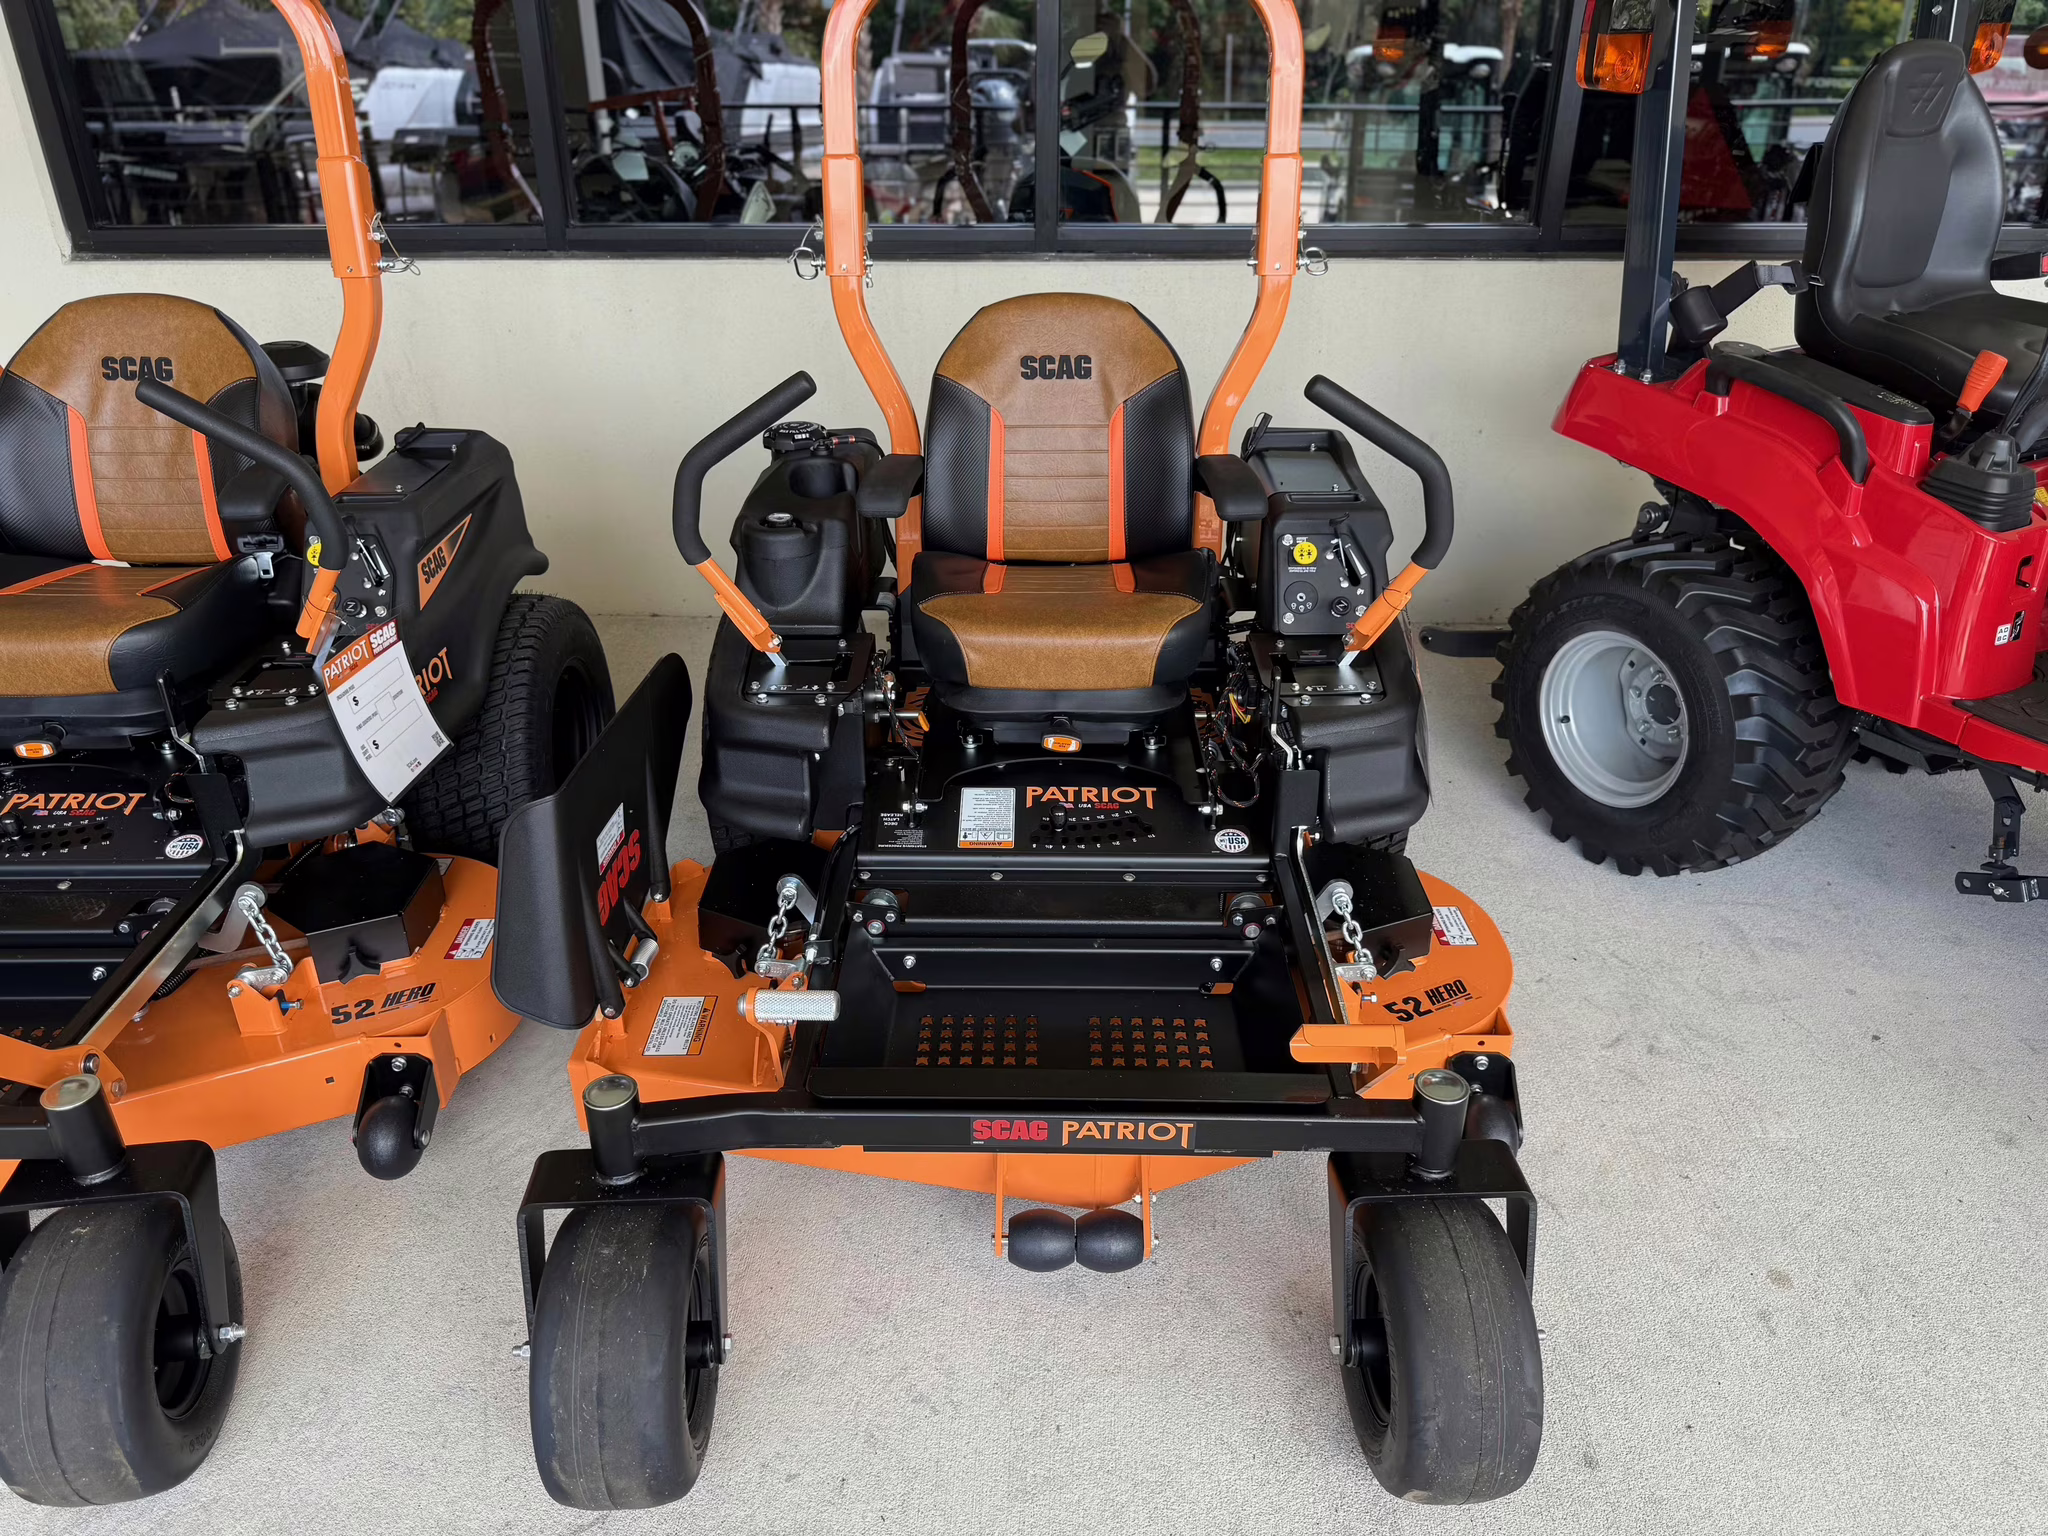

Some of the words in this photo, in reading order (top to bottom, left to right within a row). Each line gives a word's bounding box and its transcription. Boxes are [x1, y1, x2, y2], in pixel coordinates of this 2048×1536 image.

[101, 356, 174, 382] SCAG
[1020, 355, 1092, 380] SCAG
[420, 546, 447, 585] SCAG
[323, 640, 370, 689] PATRIOT
[369, 621, 397, 649] SCAG
[415, 646, 453, 696] RIOT
[0, 792, 147, 816] PATRIOT
[1025, 786, 1157, 810] PATRIOT
[180, 843, 200, 851] USA
[1228, 837, 1247, 845] USA
[597, 829, 641, 927] SCAG
[455, 926, 471, 943] DANGER
[331, 999, 376, 1025] 52
[381, 982, 437, 1009] HERO
[1381, 996, 1435, 1022] 52
[1424, 979, 1468, 1007] HERO
[693, 1013, 708, 1043] WARNING
[972, 1119, 1049, 1141] SCAG
[1062, 1120, 1194, 1149] PATRIOT
